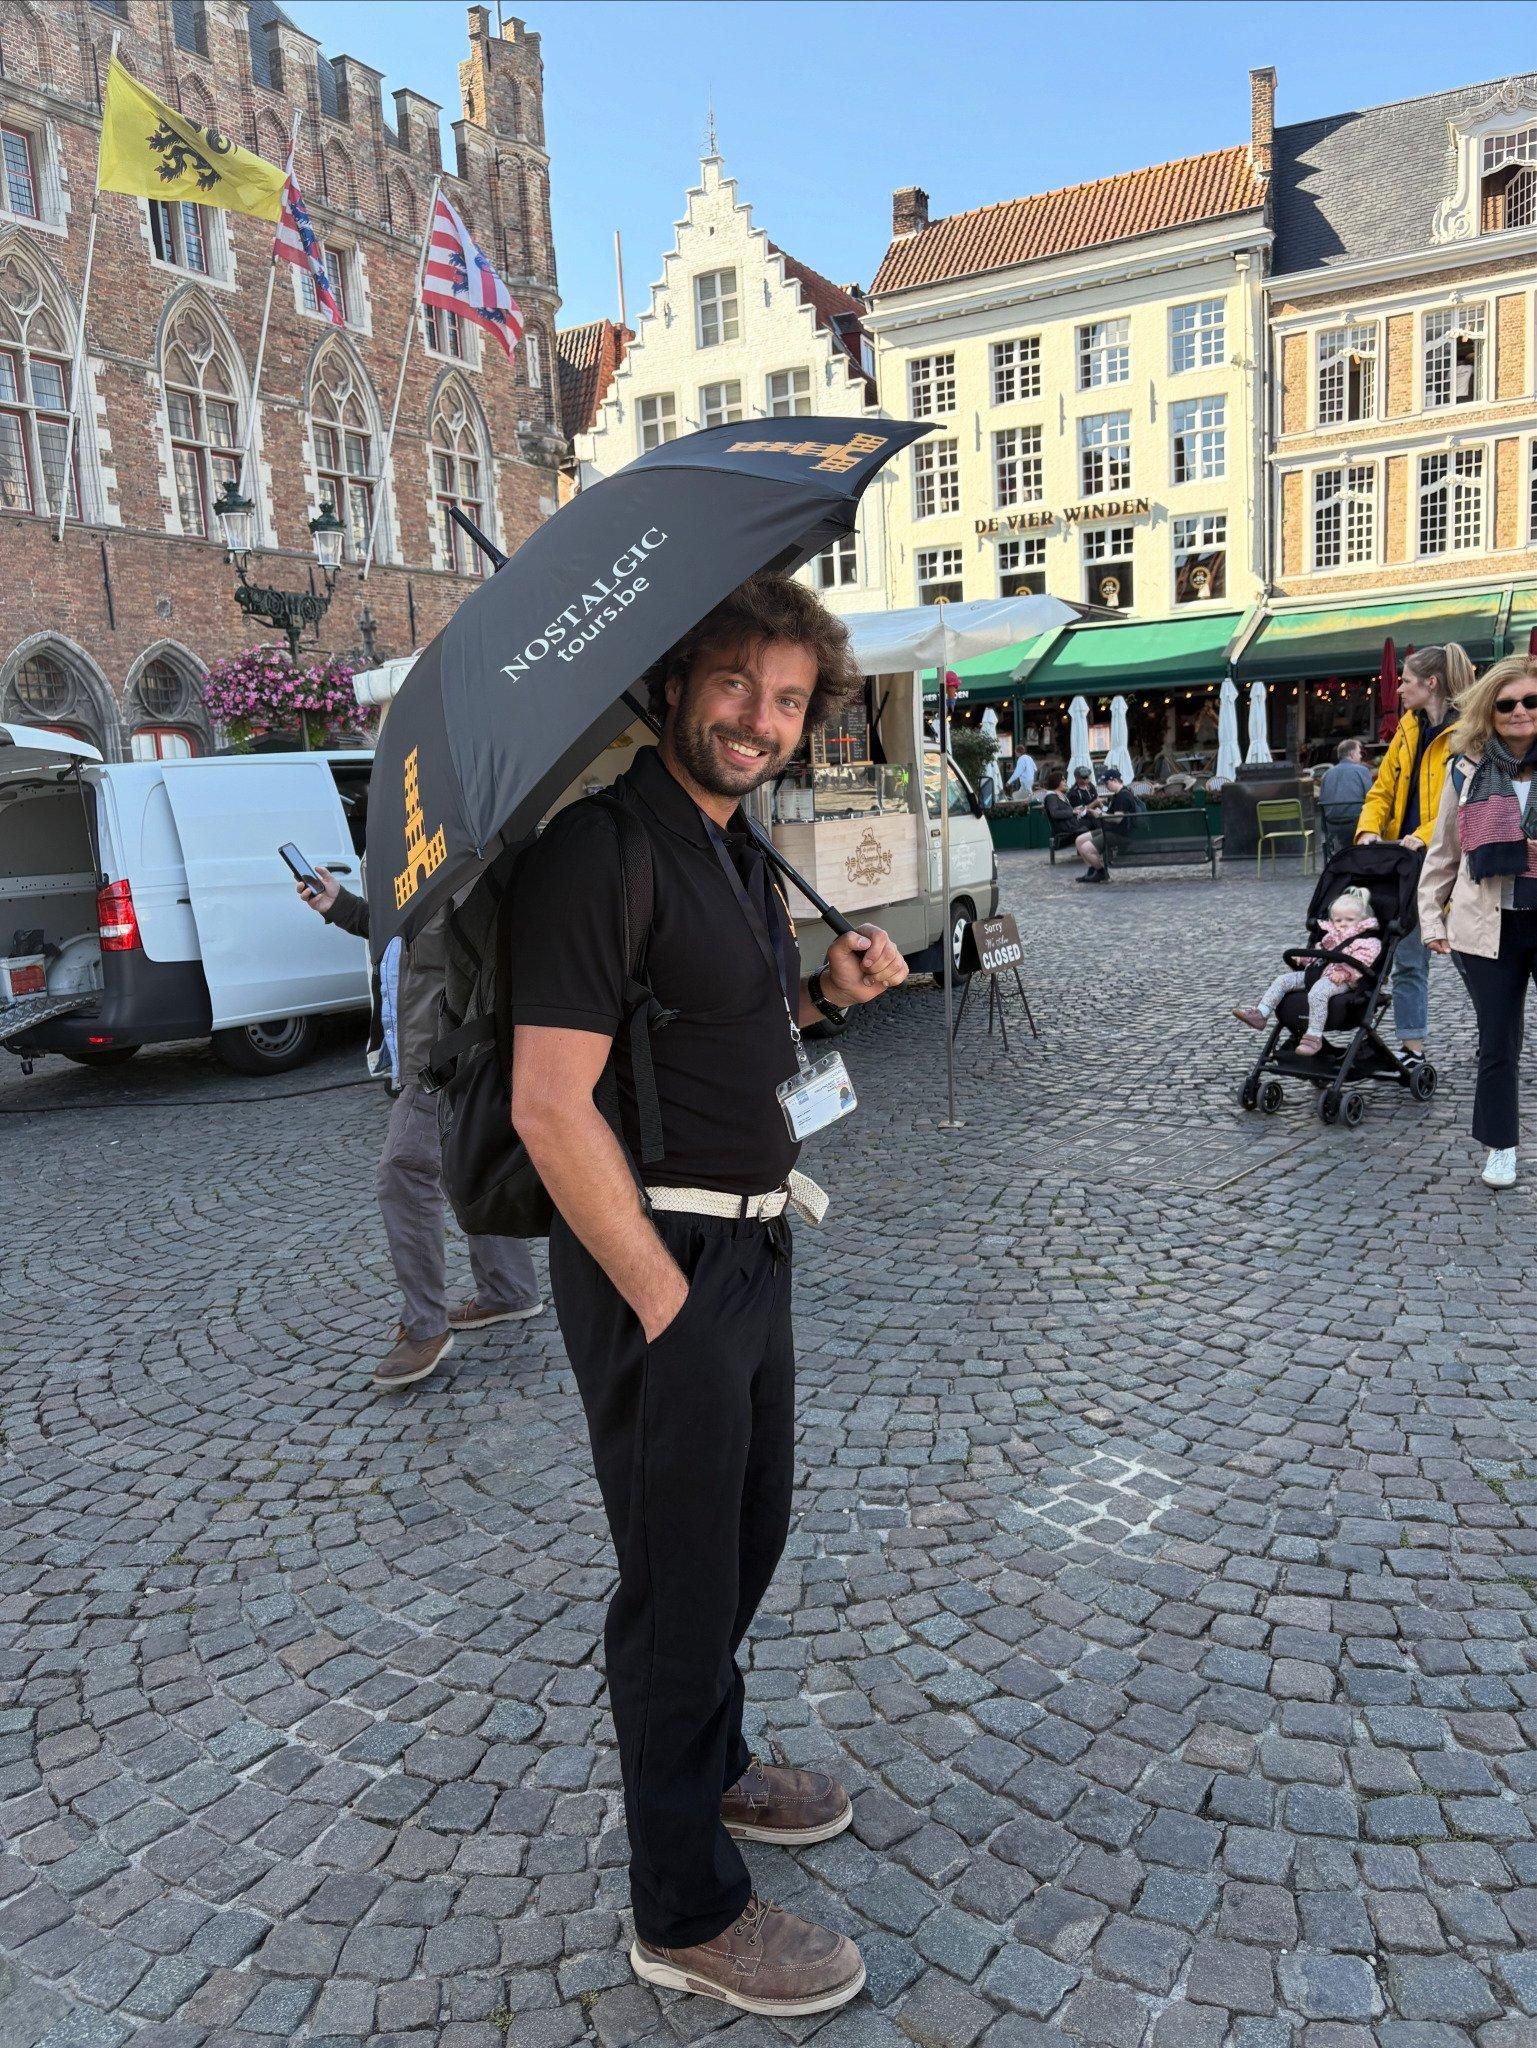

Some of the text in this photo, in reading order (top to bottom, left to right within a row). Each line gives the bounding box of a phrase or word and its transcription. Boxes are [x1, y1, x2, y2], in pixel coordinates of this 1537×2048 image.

[974, 497, 1152, 535] DE VIER WINDEN
[500, 526, 669, 684] NOSTALGIC
[557, 577, 650, 662] tours.be
[984, 922, 1002, 934] Sorry
[982, 943, 1020, 969] CLOSED
